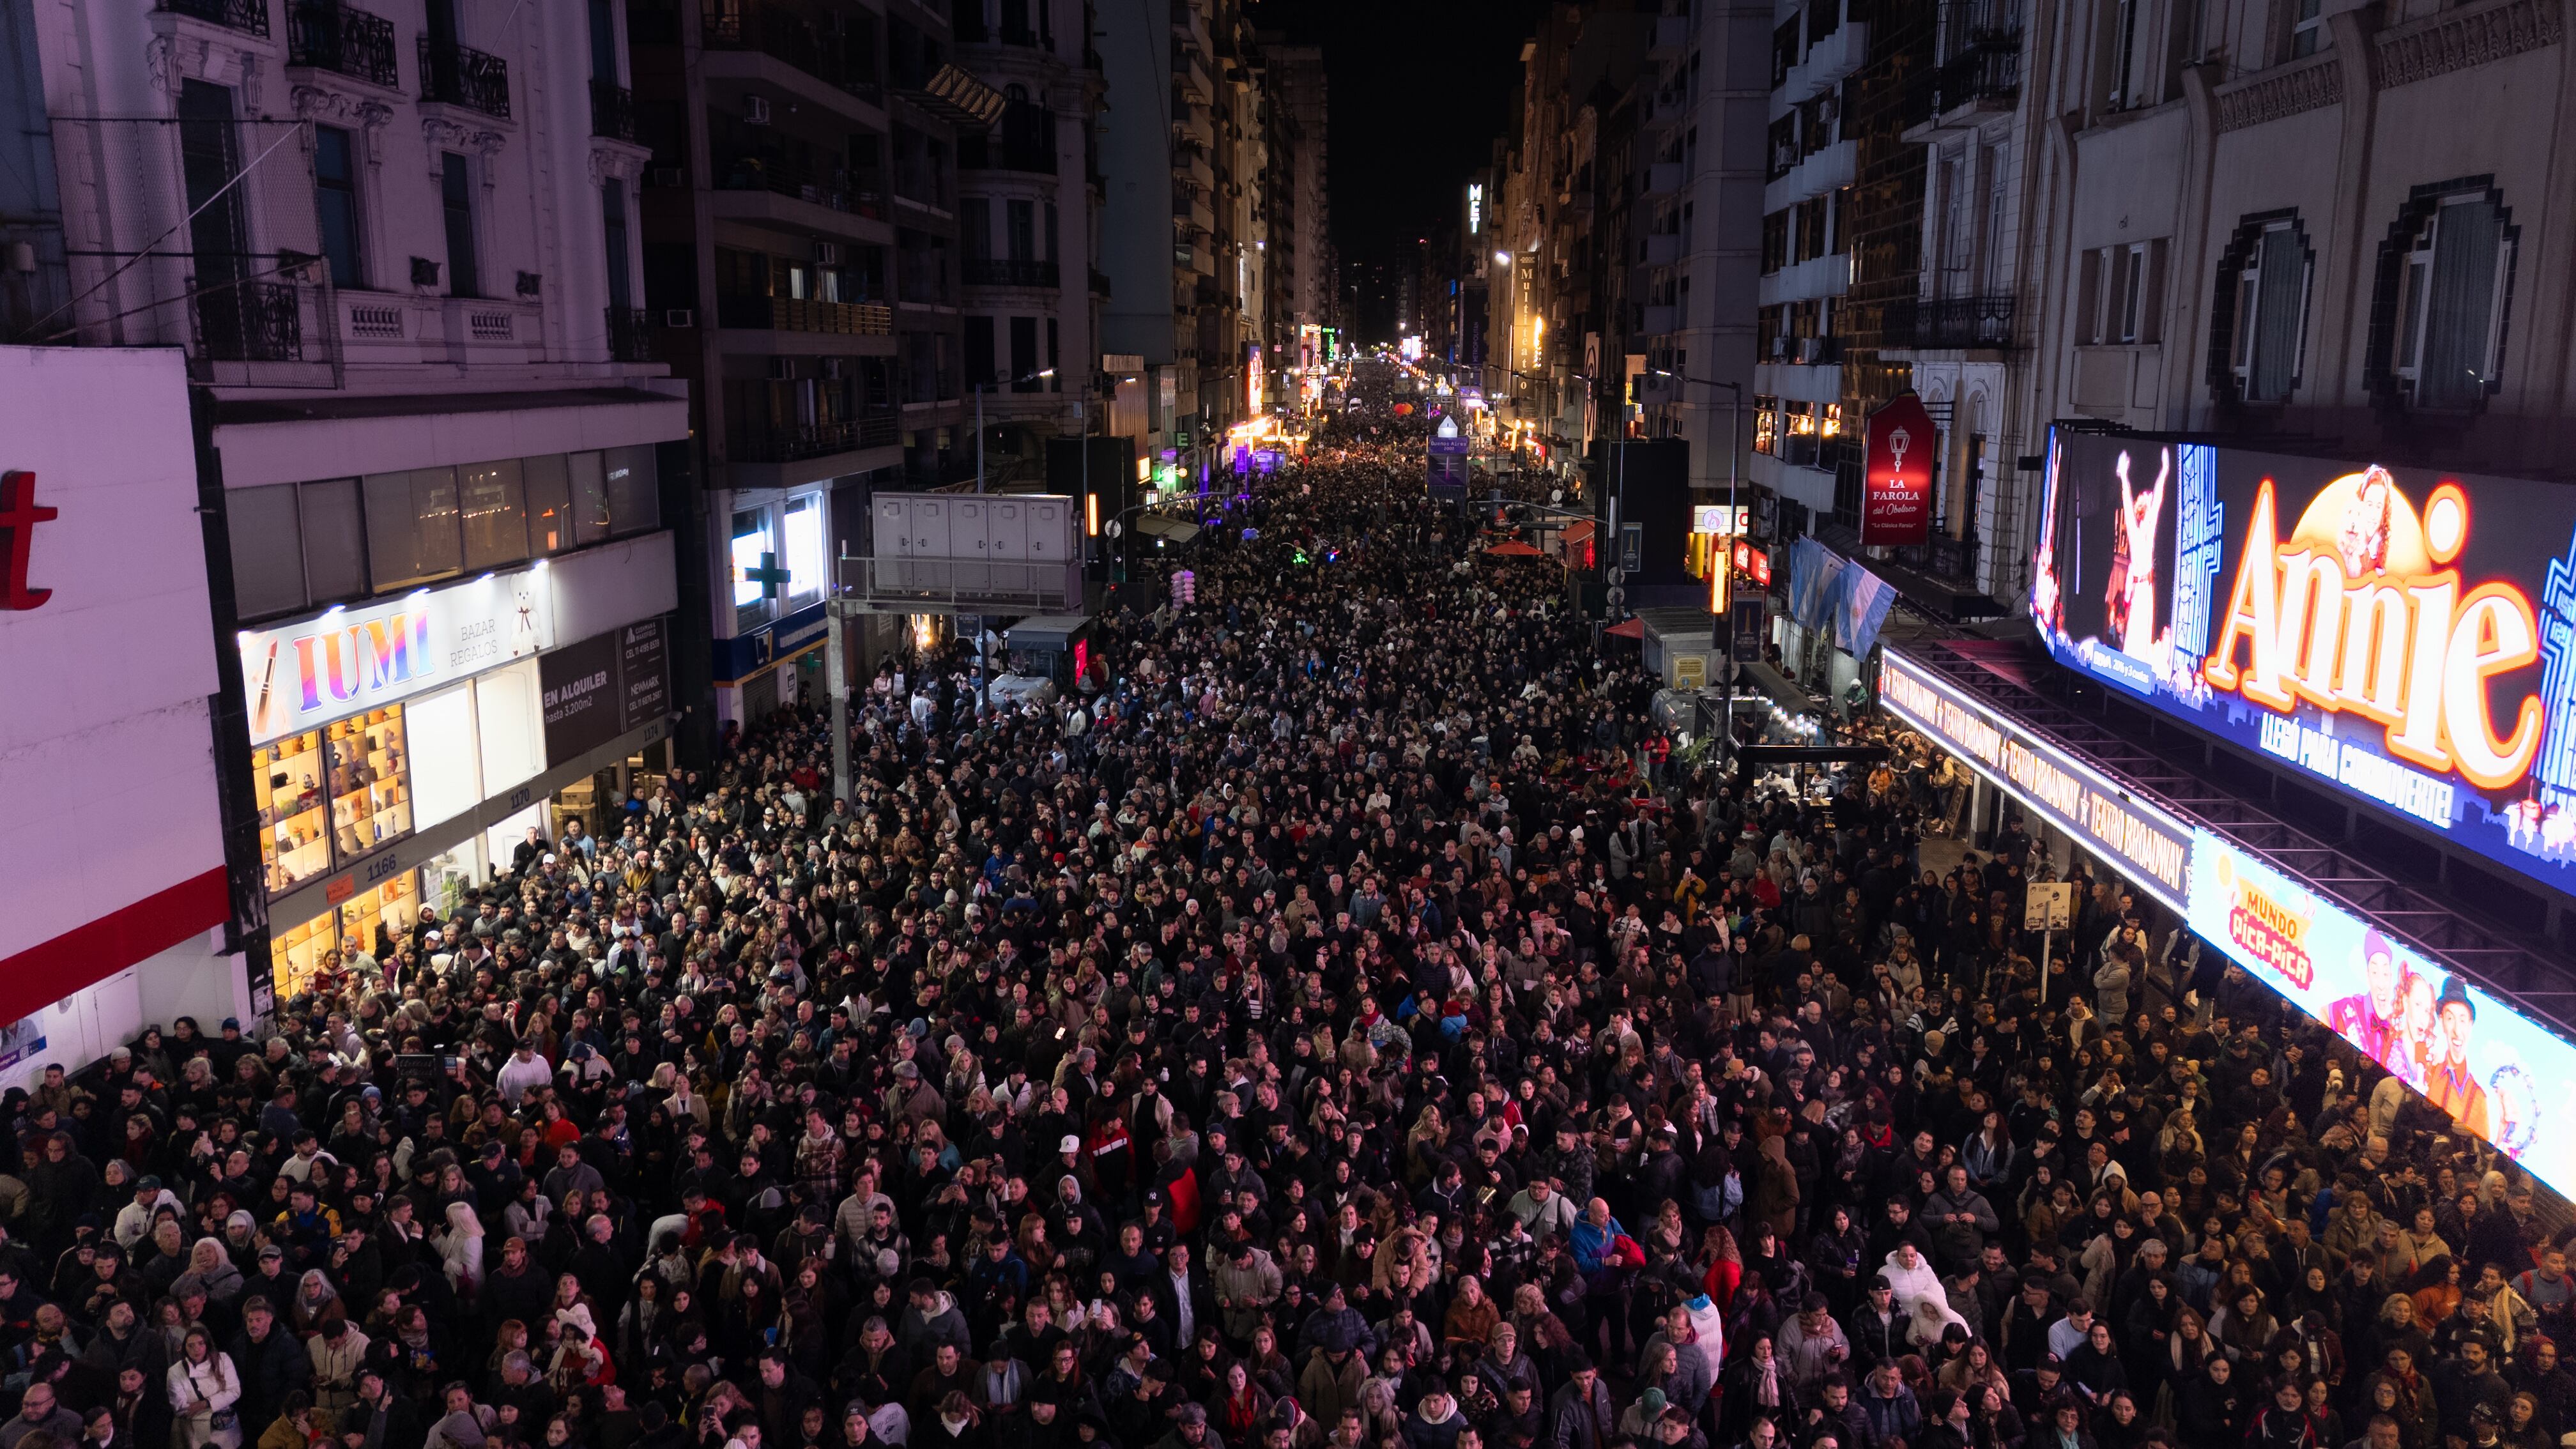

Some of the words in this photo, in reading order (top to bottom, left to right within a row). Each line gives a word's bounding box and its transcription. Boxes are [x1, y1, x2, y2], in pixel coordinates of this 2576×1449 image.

[1469, 184, 1482, 234] MET
[1177, 433, 1188, 446] E
[1873, 491, 1920, 500] FAROLA
[1889, 480, 1905, 489] LA
[1873, 506, 1884, 515] del
[1886, 503, 1917, 516] Obelisco
[461, 620, 496, 643] BAZAR
[2206, 479, 2543, 790] Annie
[292, 607, 435, 714] IUMI
[450, 640, 498, 668] REGALOS
[625, 648, 634, 659] CEL
[544, 690, 558, 709] EN
[561, 671, 607, 702] ALQUILER
[631, 675, 659, 696] NEWMARK
[546, 709, 564, 724] hasta
[565, 695, 593, 716] 3.200m2
[629, 698, 637, 711] CEL
[643, 724, 659, 742] 1174
[1890, 668, 1909, 707] TEATRO
[1908, 678, 1938, 725] BROADWAY
[1944, 701, 1965, 745] TEATRO
[1964, 714, 2002, 767] BROADWAY
[2009, 740, 2035, 790] TEATRO
[2034, 758, 2080, 824] BROADWAY
[2090, 792, 2124, 850] TEATRO
[2122, 813, 2184, 893] BROADWAY
[2260, 712, 2300, 762] LLEGÓ
[2299, 727, 2340, 779] PARA
[2339, 744, 2455, 829] CONMOVERTE!
[510, 787, 530, 810] 1170
[367, 854, 397, 883] 1166
[2247, 891, 2297, 939] MUNDO
